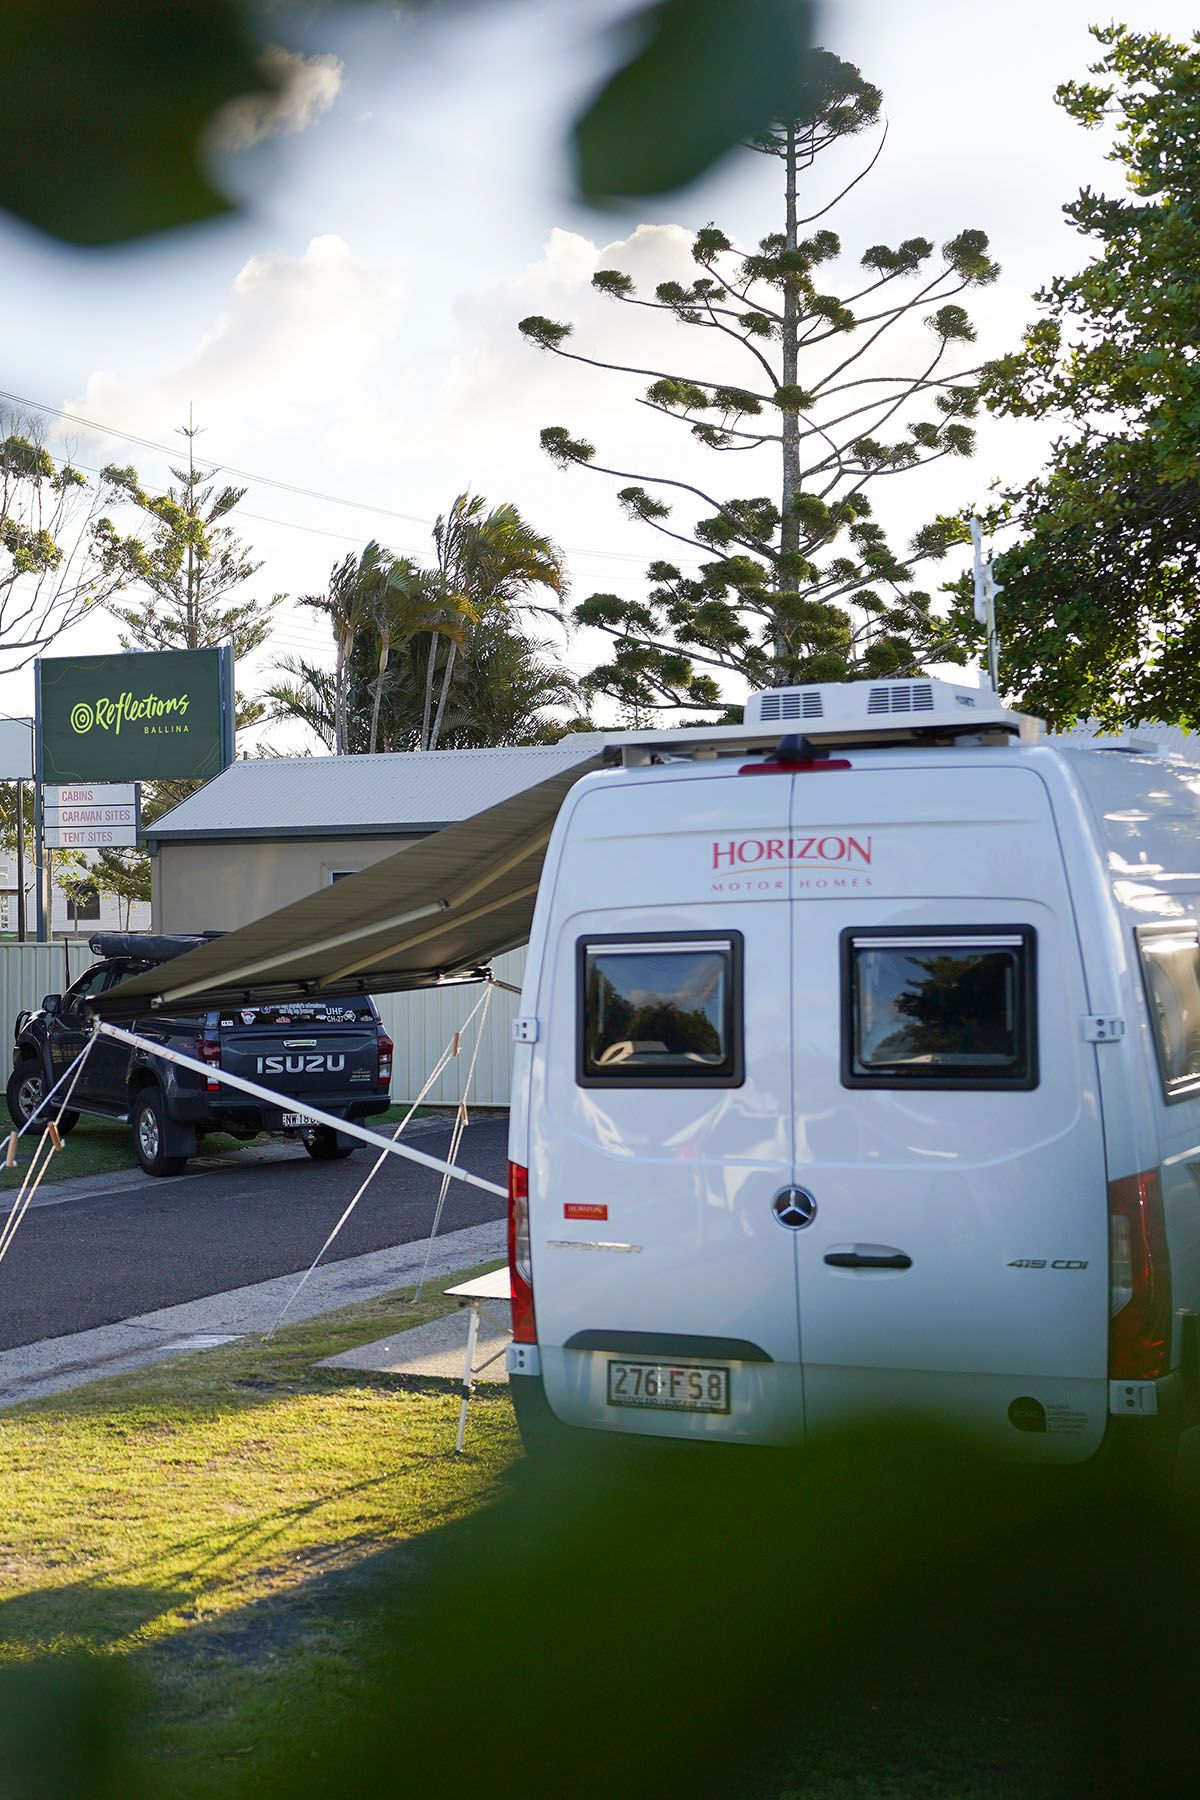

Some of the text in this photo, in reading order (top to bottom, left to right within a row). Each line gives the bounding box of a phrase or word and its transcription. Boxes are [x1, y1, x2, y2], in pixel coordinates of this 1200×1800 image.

[95, 692, 190, 735] Reflections
[144, 725, 189, 734] BALLINA
[61, 790, 94, 802] CABINS
[62, 810, 130, 822] CARAVAN SITES
[62, 831, 113, 843] TENT SITES
[712, 836, 872, 870] HORIZON
[711, 878, 873, 892] MOTOR HOMES
[325, 1007, 344, 1015] UHF
[256, 1054, 345, 1074] ISUZU
[1050, 1260, 1089, 1270] CDI
